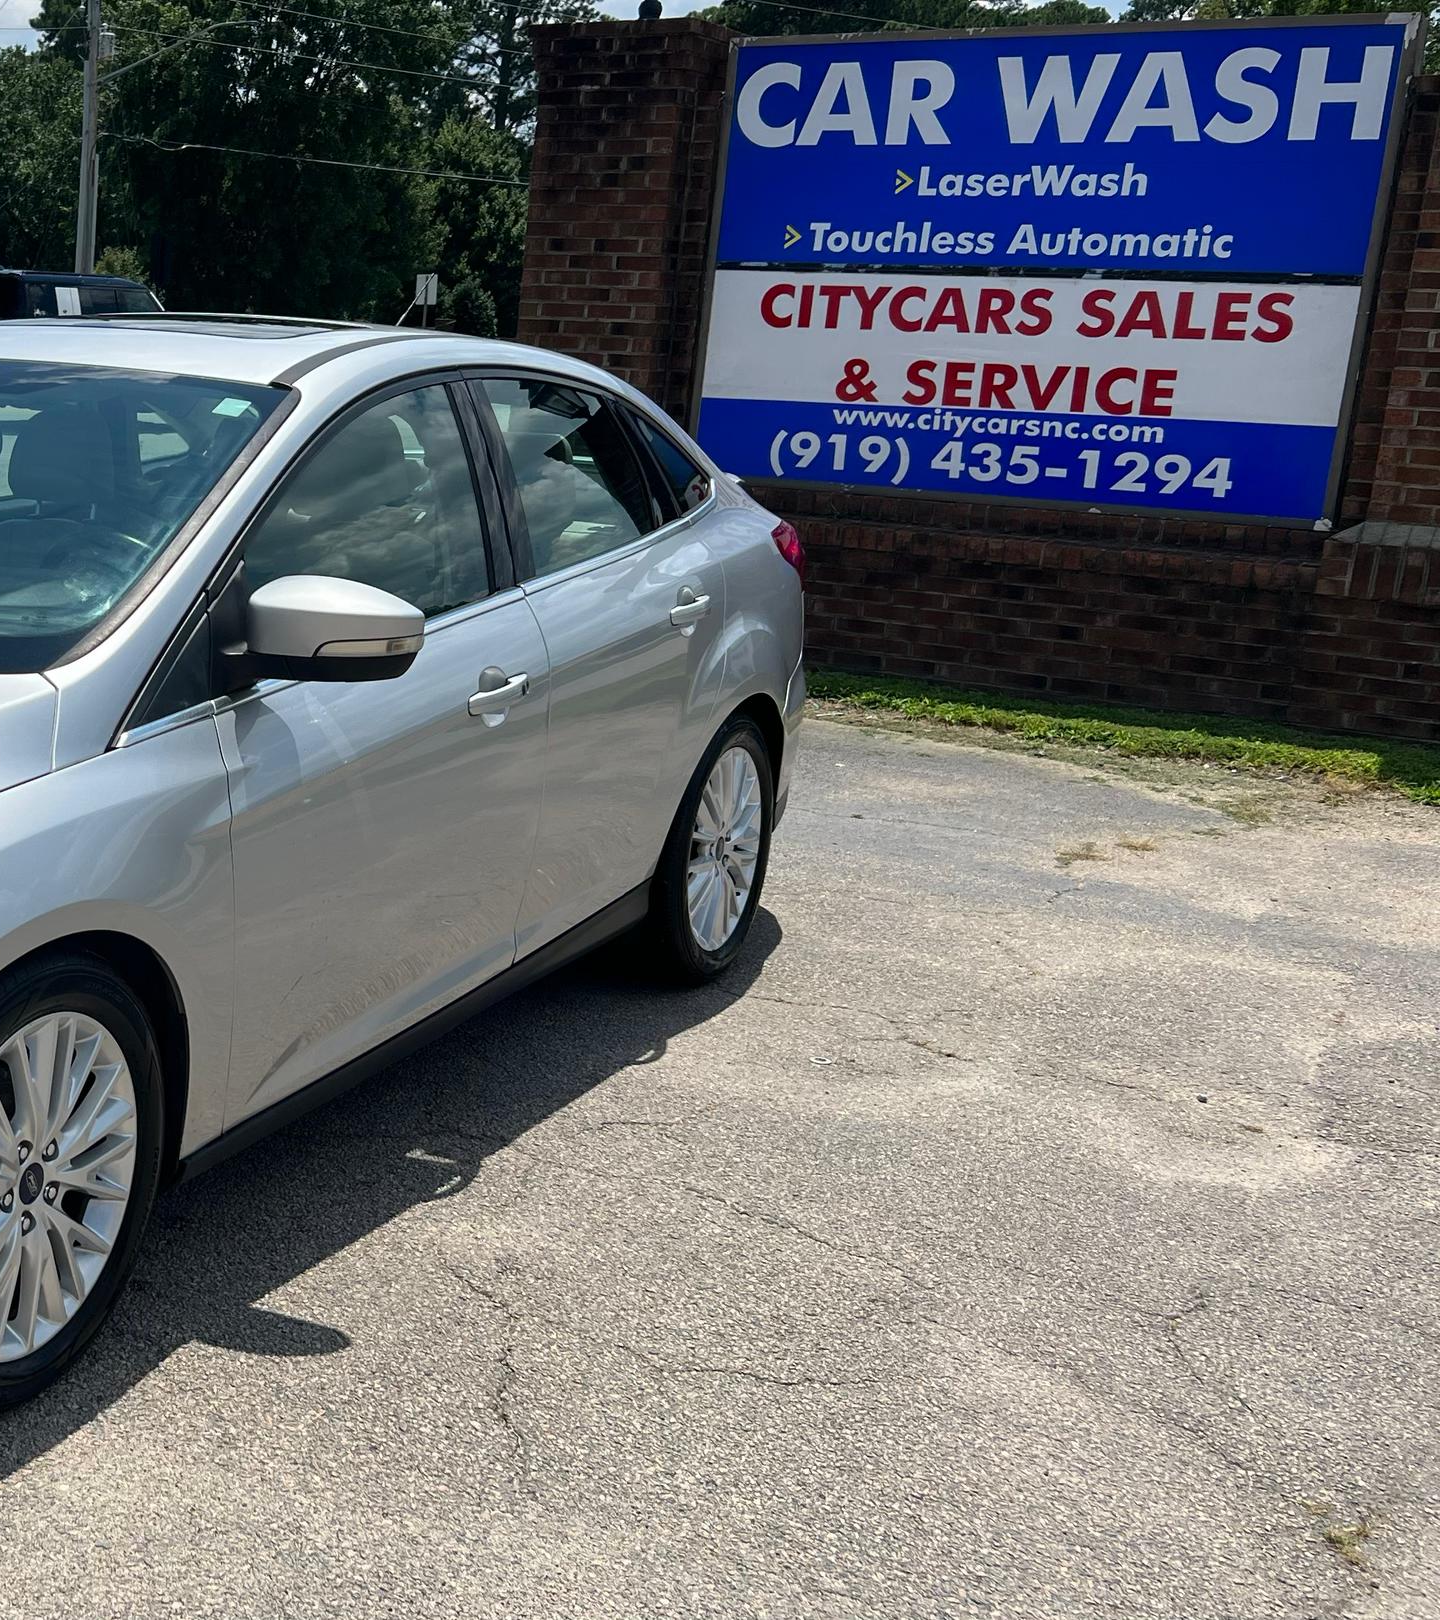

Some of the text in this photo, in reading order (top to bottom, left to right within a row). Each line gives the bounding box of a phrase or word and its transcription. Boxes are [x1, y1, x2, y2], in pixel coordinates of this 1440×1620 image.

[736, 45, 1396, 148] CAR WASH
[917, 163, 1150, 199] LaserWash
[809, 223, 1235, 259] Touchless Automatic
[760, 284, 1295, 344] CITYCARS SALES
[835, 358, 1178, 416] & SERVICE
[833, 408, 1165, 445] www.citycarsnc.com
[769, 430, 1233, 499] (919) 435-1294
